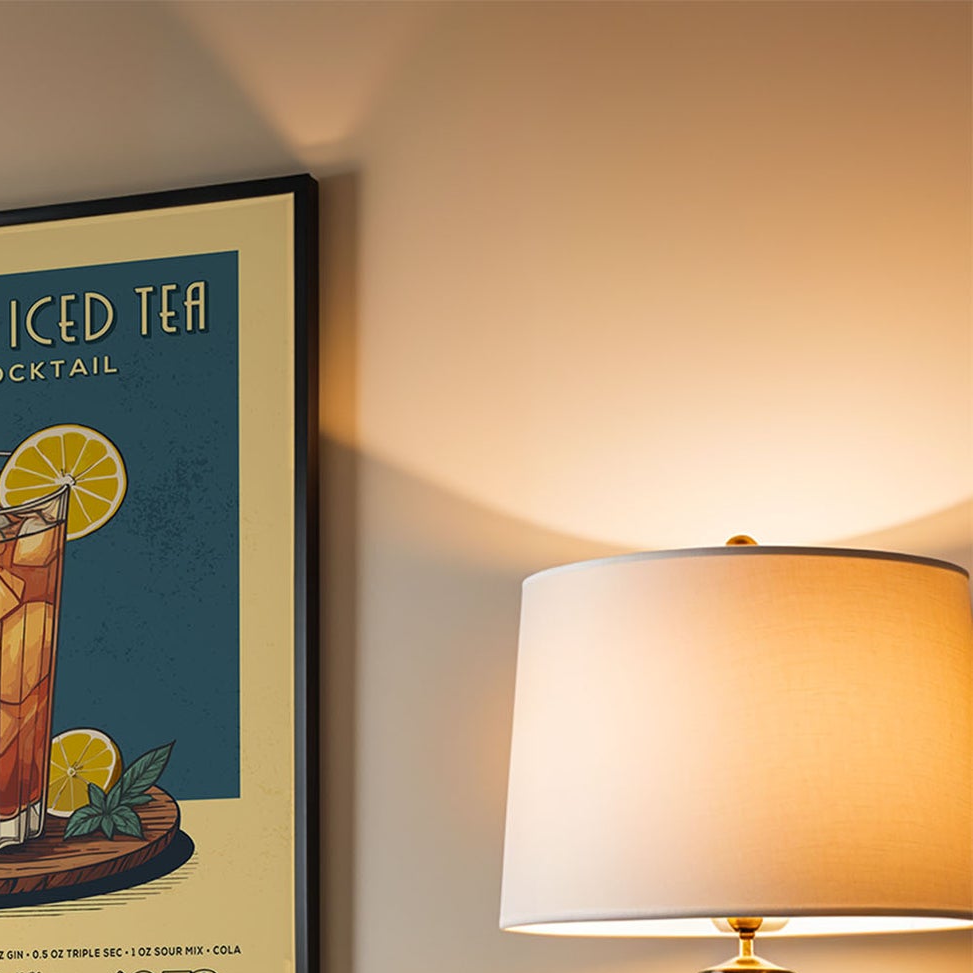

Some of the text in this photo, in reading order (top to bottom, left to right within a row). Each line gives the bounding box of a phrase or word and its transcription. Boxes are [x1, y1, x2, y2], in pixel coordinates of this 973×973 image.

[10, 292, 114, 348] ICED
[134, 281, 206, 336] TEA
[7, 950, 23, 959] GIN
[32, 950, 48, 959] 0.5
[50, 949, 64, 958] OZ
[67, 948, 100, 958] TRIPLE
[103, 948, 122, 957] SEC
[131, 948, 135, 956] 1
[138, 947, 151, 956] OZ
[154, 946, 182, 956] SOUR
[185, 946, 203, 955] MIX
[213, 945, 241, 955] COLA
